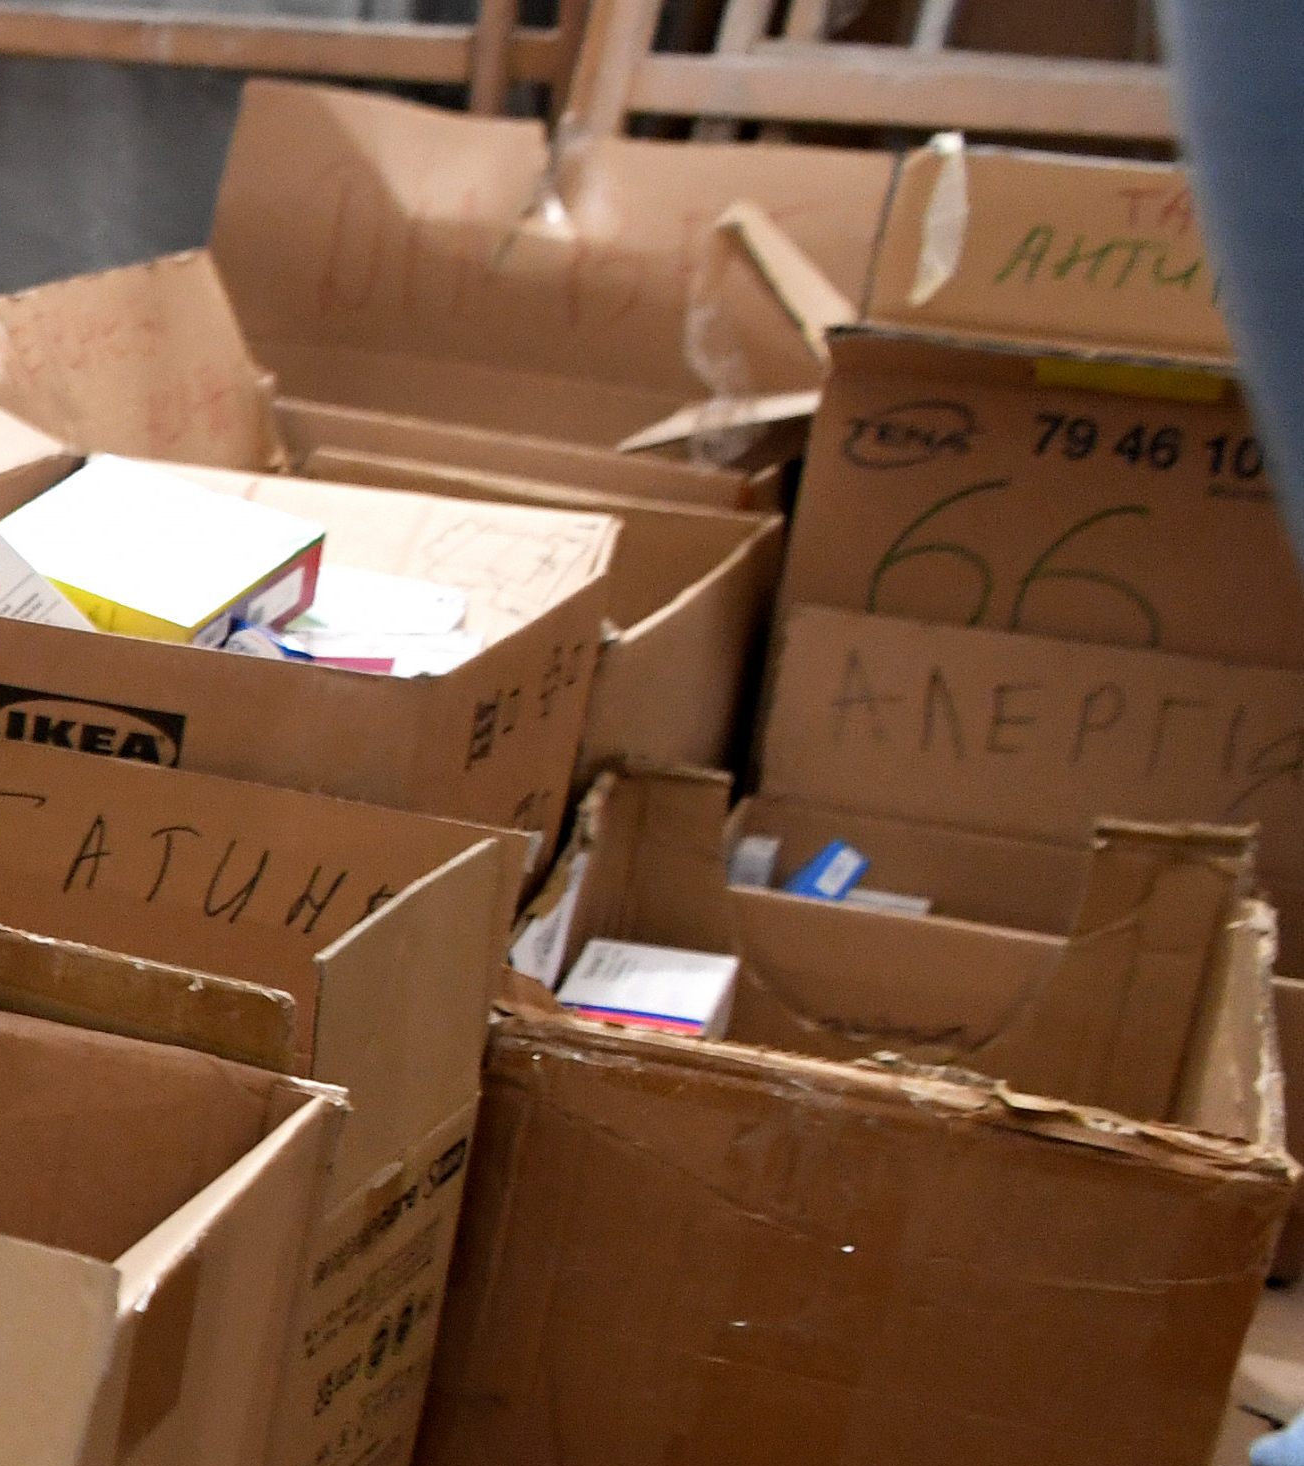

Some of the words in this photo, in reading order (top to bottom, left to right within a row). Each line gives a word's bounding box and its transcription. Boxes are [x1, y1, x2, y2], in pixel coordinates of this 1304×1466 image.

[995, 224, 1223, 306] АНТИ
[1035, 409, 1099, 461] 79
[1114, 422, 1183, 471] 46
[5, 710, 161, 765] IKEA
